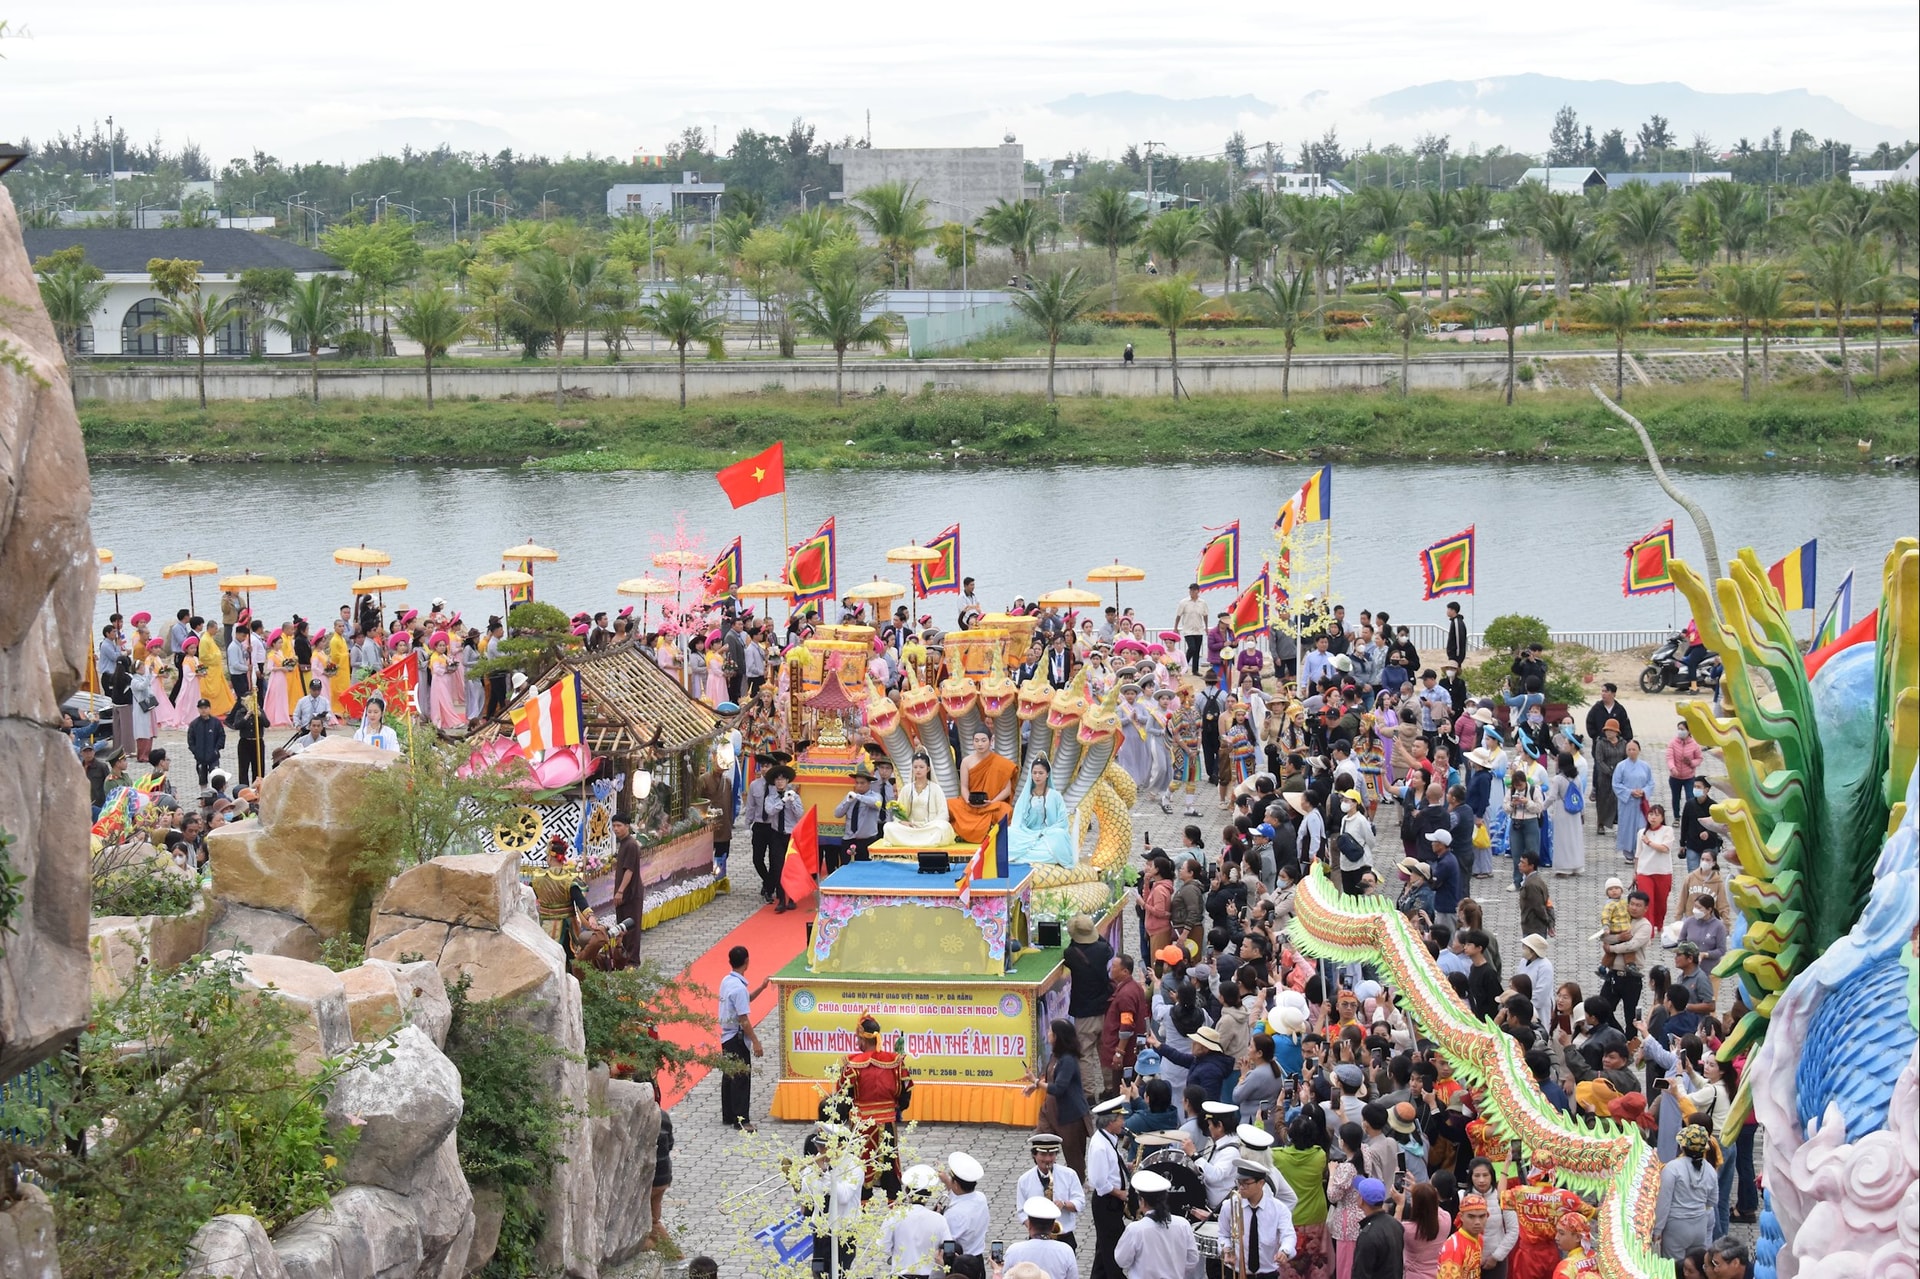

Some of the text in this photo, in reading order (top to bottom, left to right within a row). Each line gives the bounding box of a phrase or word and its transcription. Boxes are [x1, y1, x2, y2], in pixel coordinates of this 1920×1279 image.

[857, 991, 868, 999] HỘI
[869, 991, 884, 1000] PHẬT
[901, 992, 914, 1000] VIỆT
[818, 1002, 840, 1012] CHÙA
[866, 1002, 881, 1013] THẾ
[883, 1003, 897, 1013] ÂM
[899, 1004, 916, 1014] NGŨ
[919, 1004, 938, 1014] GIÁC
[941, 1003, 955, 1015] ĐÀI
[957, 1006, 973, 1015] SEN
[975, 1006, 998, 1017] NGỌC
[794, 1027, 824, 1051] KÍNH
[908, 1031, 942, 1057] QUÁN
[945, 1028, 970, 1055] THẾ
[973, 1032, 991, 1055] ÂM
[996, 1036, 1024, 1056] 19/2
[964, 1069, 976, 1077] DL:
[1524, 1193, 1561, 1203] VIETNAM
